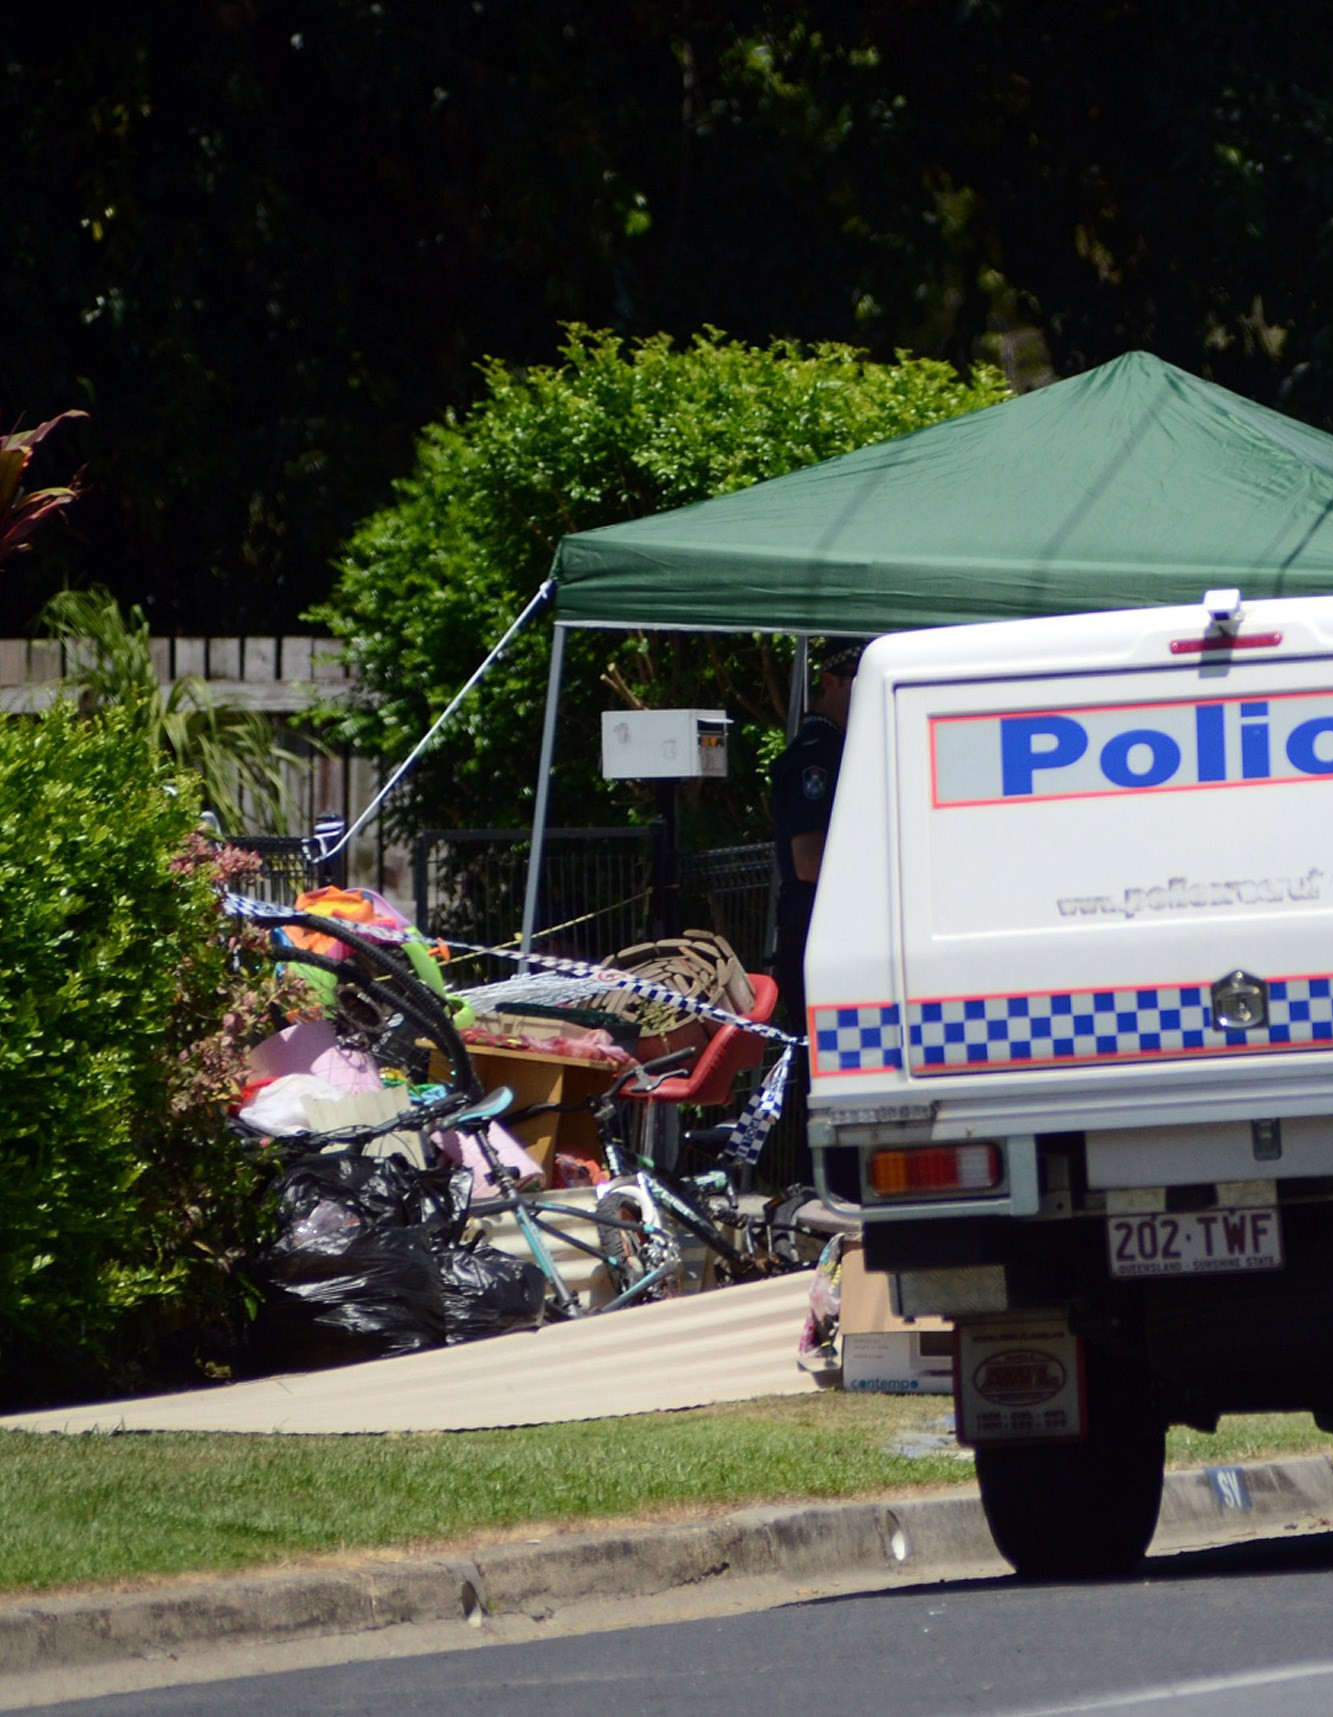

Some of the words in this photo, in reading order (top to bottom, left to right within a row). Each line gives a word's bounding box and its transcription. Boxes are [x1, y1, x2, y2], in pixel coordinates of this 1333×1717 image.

[1118, 1261, 1182, 1275] QUEENSLAND
[1192, 1257, 1241, 1271] SUNSHINE
[1246, 1255, 1275, 1267] STATE
[851, 1377, 919, 1391] contempo
[1217, 1471, 1242, 1509] SV
